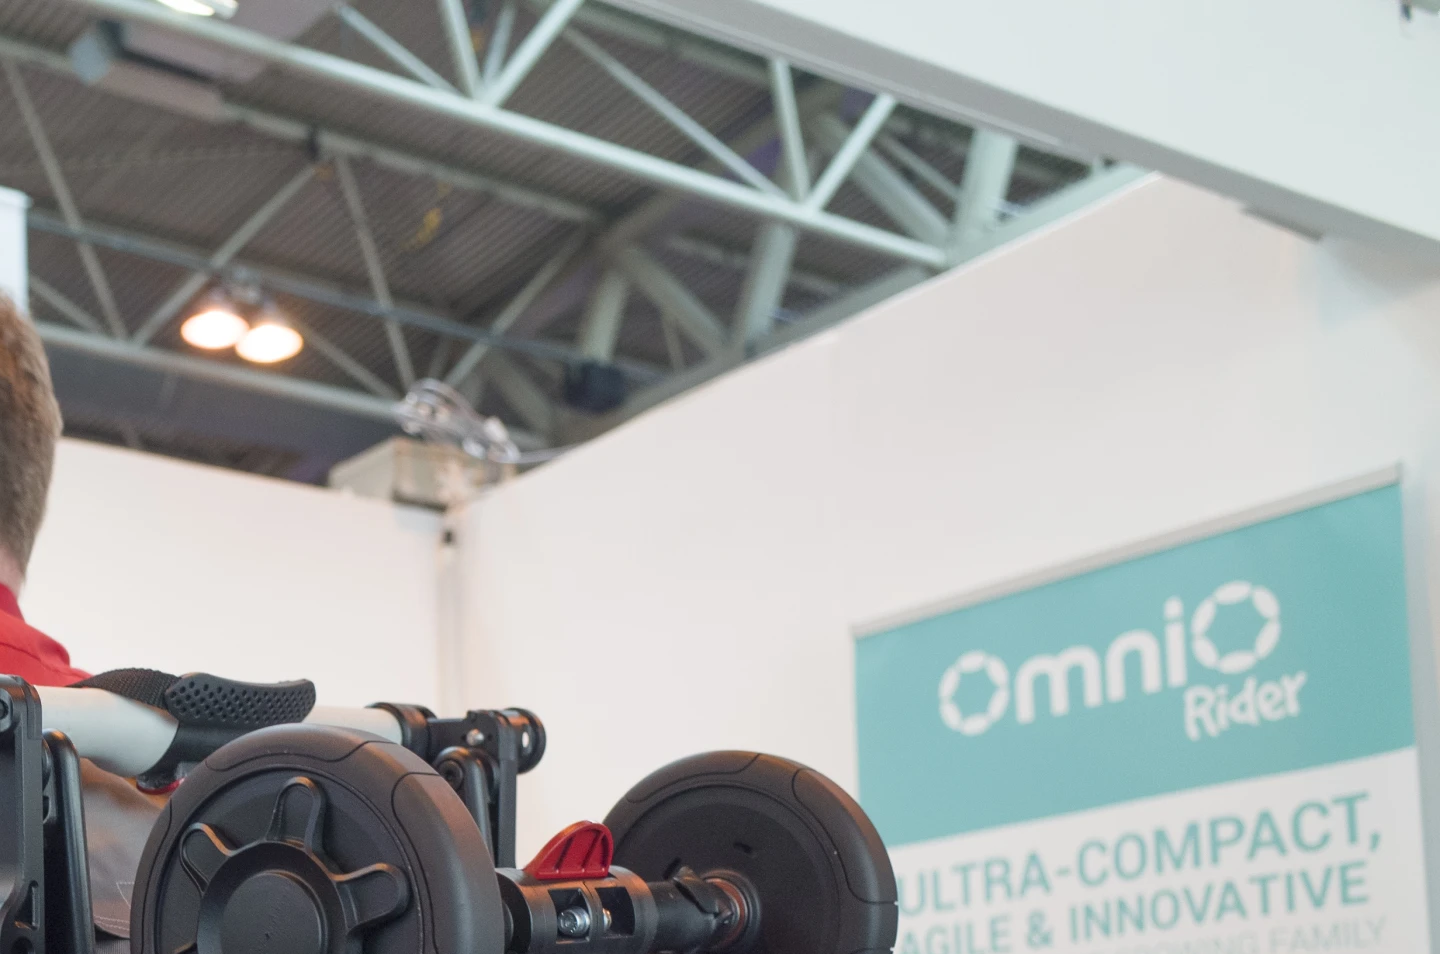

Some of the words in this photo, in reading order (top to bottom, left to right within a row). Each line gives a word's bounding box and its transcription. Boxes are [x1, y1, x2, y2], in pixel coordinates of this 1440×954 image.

[1184, 671, 1307, 740] Rider
[898, 791, 1382, 917] ULTRA-COMPACT,
[1026, 908, 1053, 950] &
[1069, 860, 1370, 945] INNOVATIVE
